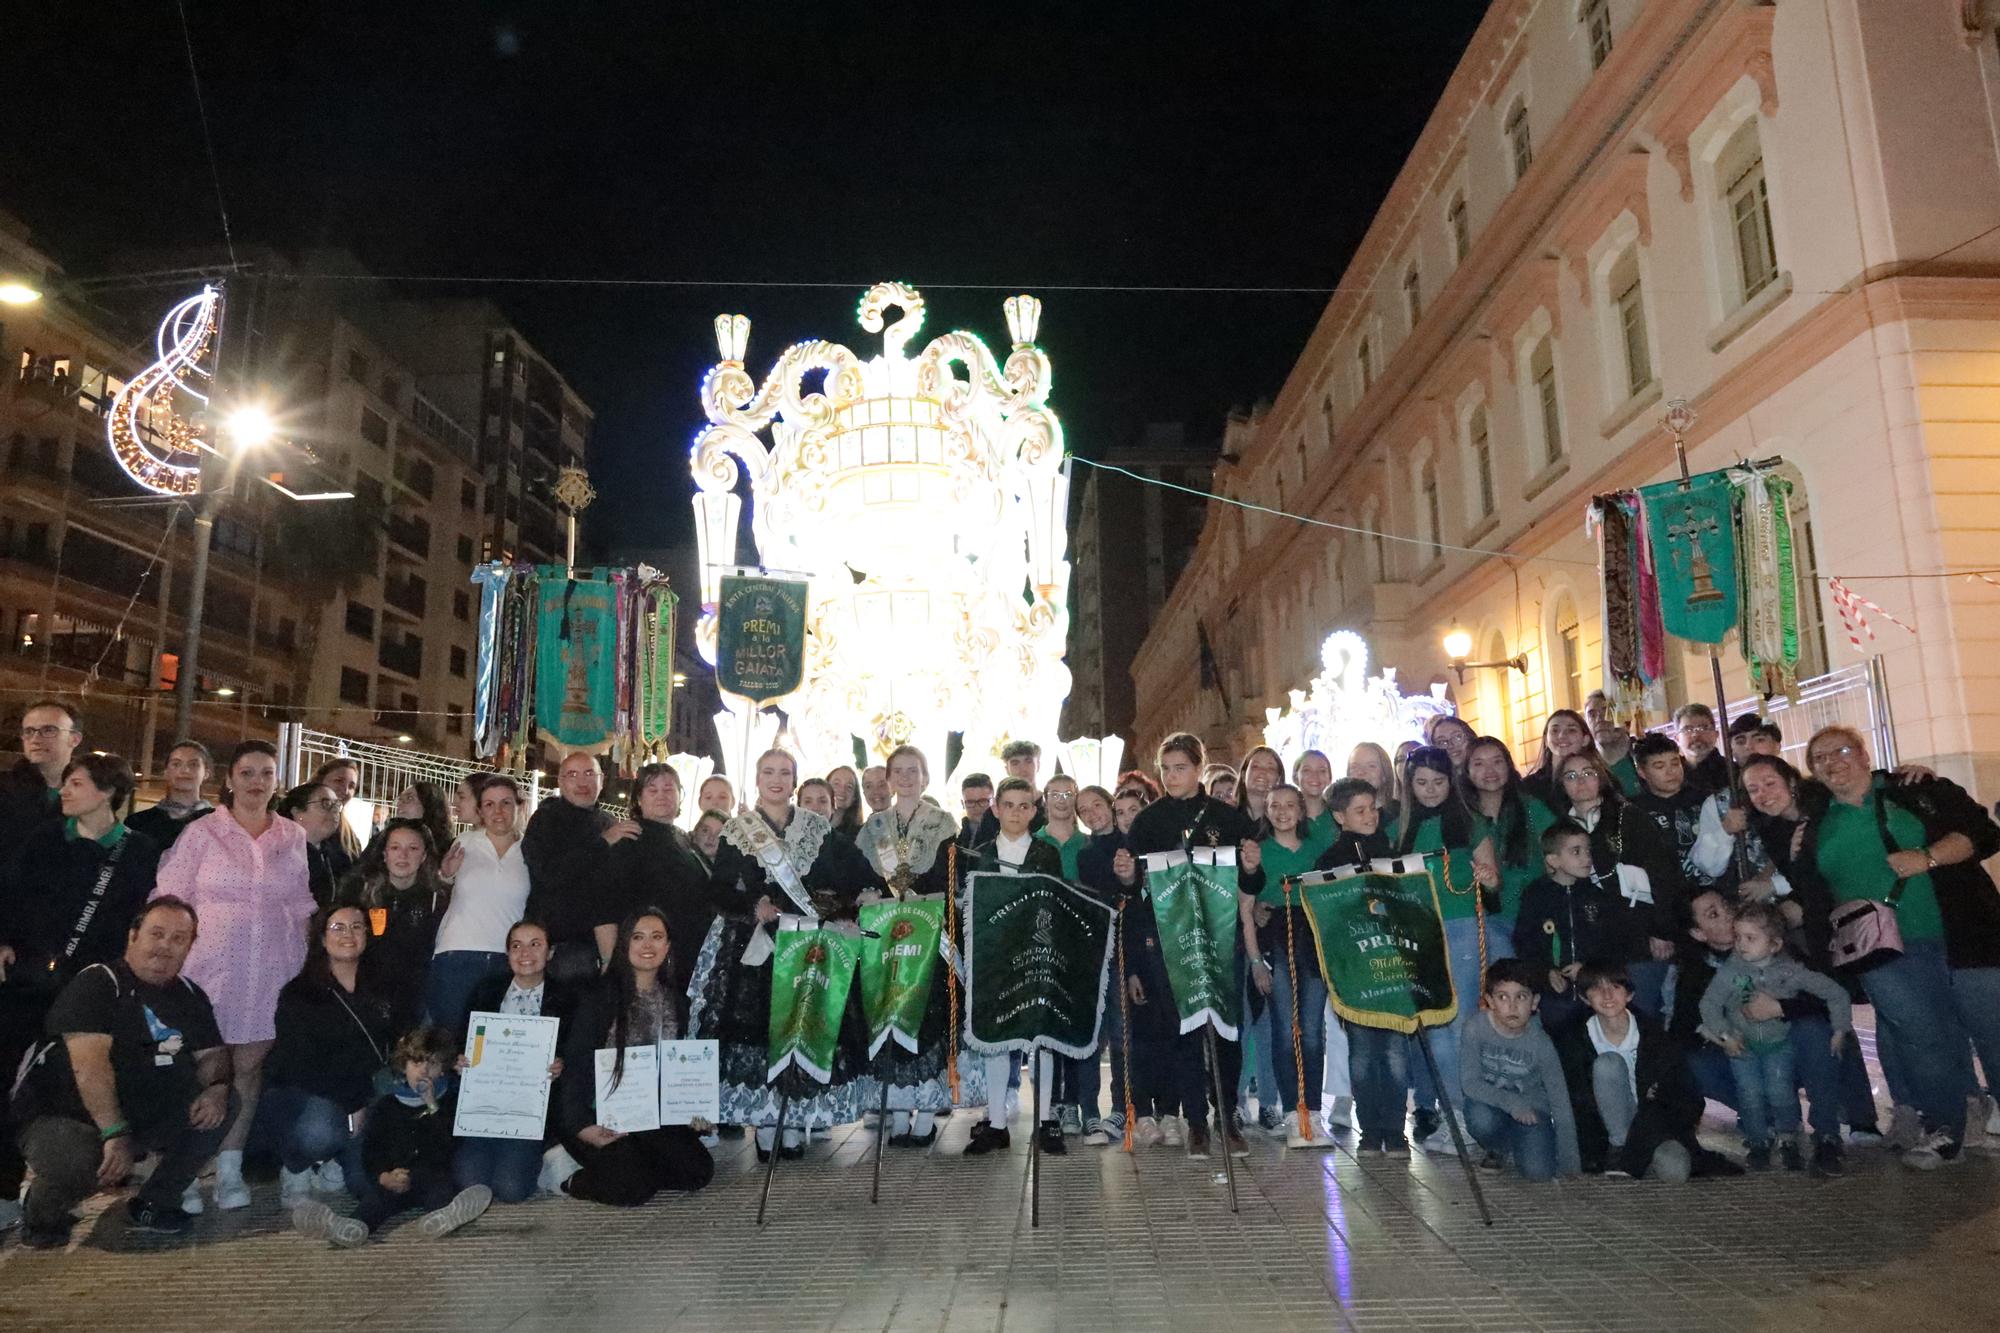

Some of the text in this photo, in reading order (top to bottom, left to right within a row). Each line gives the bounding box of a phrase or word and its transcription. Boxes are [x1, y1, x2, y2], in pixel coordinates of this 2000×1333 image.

[743, 618, 781, 636] PREMI
[735, 644, 786, 660] MILLOR
[735, 660, 785, 678] GAIATA
[1157, 871, 1233, 903] PREMI GENERALITAT
[76, 900, 100, 933] BIMBA
[93, 865, 115, 896] BIMBA
[1355, 934, 1419, 953] PREMI
[881, 944, 922, 965] PREMI
[793, 966, 830, 990] PREMI
